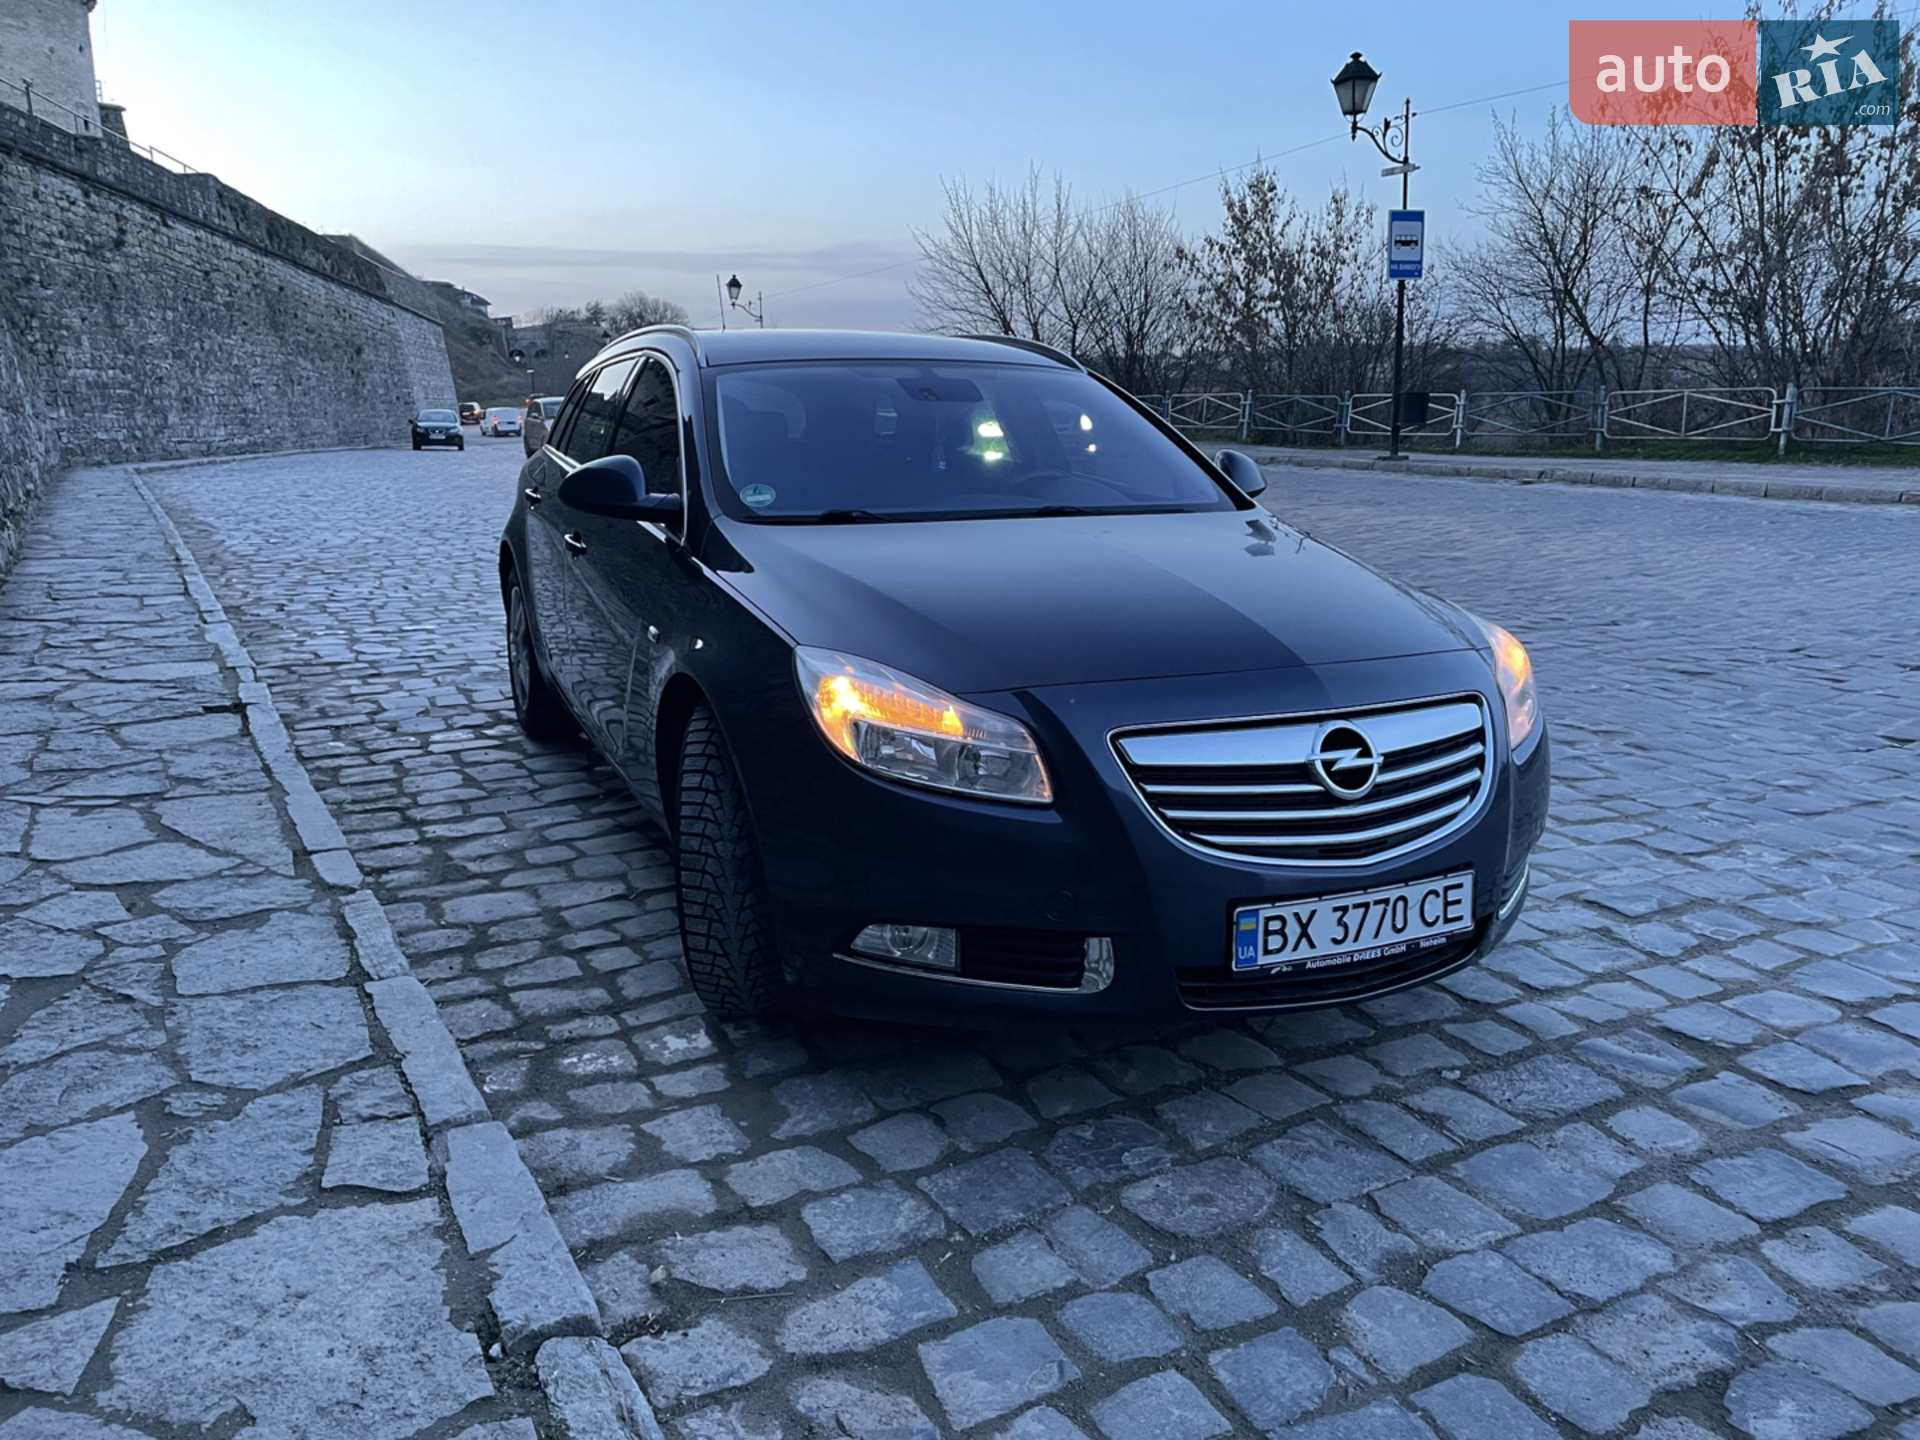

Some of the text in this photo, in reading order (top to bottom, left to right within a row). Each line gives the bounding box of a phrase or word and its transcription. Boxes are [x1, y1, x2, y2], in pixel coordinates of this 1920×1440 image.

[1262, 883, 1464, 956] BX 3770 CE
[1238, 945, 1256, 960] UA
[1305, 955, 1352, 969] Automobile
[1352, 949, 1381, 961] DREES
[1383, 944, 1407, 956] GmbH
